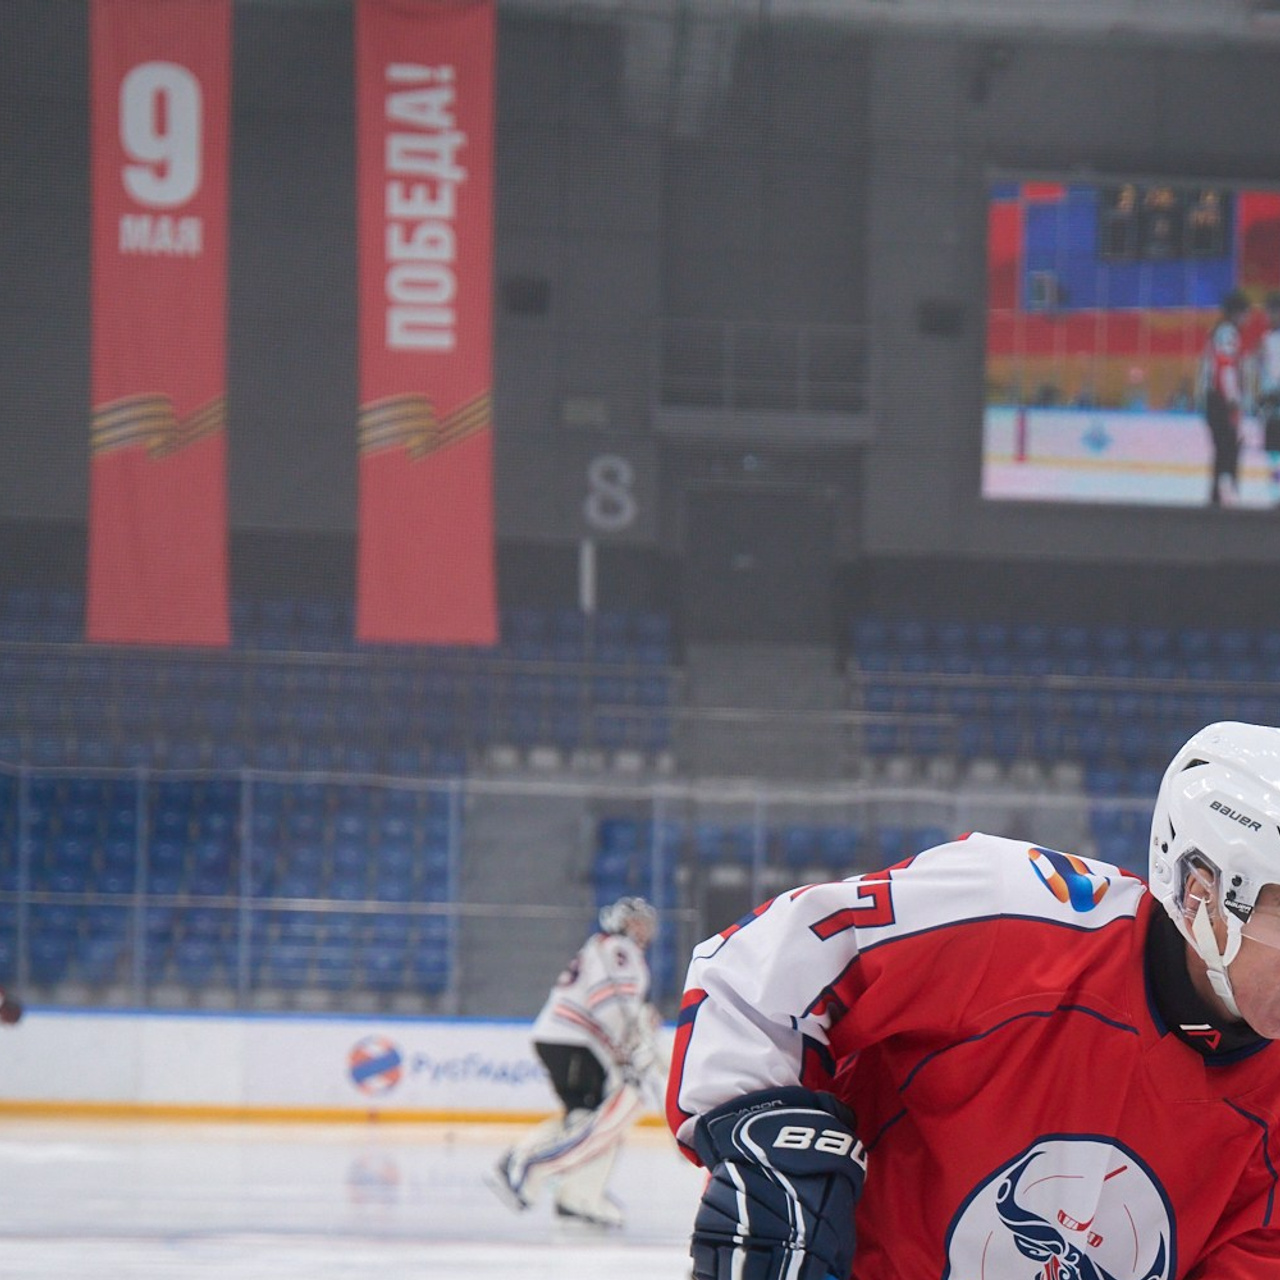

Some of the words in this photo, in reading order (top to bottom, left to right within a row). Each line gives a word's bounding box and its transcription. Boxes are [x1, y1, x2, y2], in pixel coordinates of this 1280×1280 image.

[119, 61, 201, 208] 9
[119, 214, 202, 255] МАЯ
[385, 64, 466, 351] ПОБЕДА!
[585, 456, 637, 531] 8
